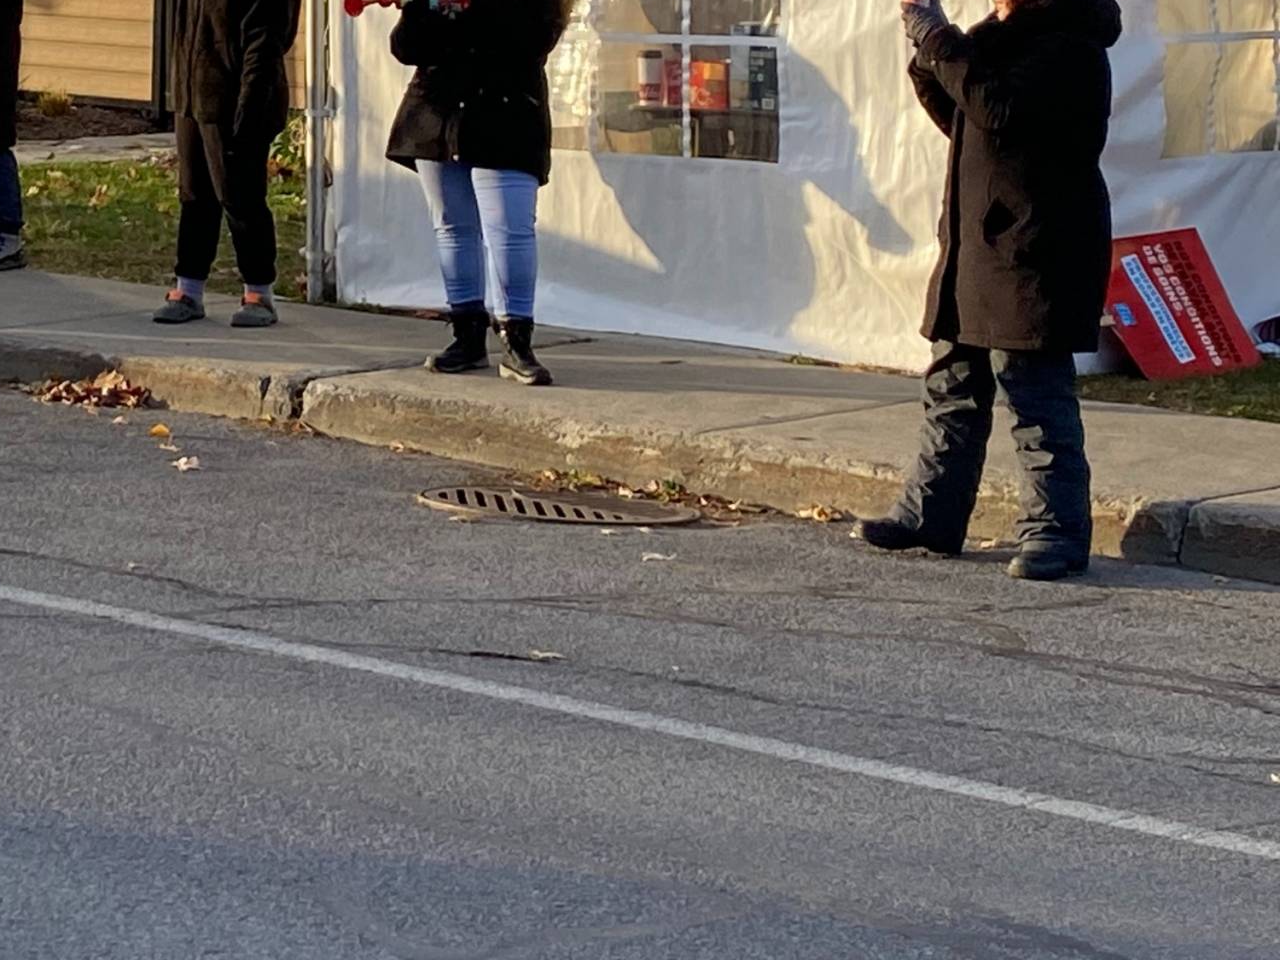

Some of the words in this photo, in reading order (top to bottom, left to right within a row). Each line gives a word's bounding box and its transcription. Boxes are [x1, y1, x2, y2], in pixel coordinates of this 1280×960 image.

[1142, 245, 1157, 264] DE
[1153, 243, 1174, 274] VOS
[1169, 276, 1222, 366] CONDITIONS
